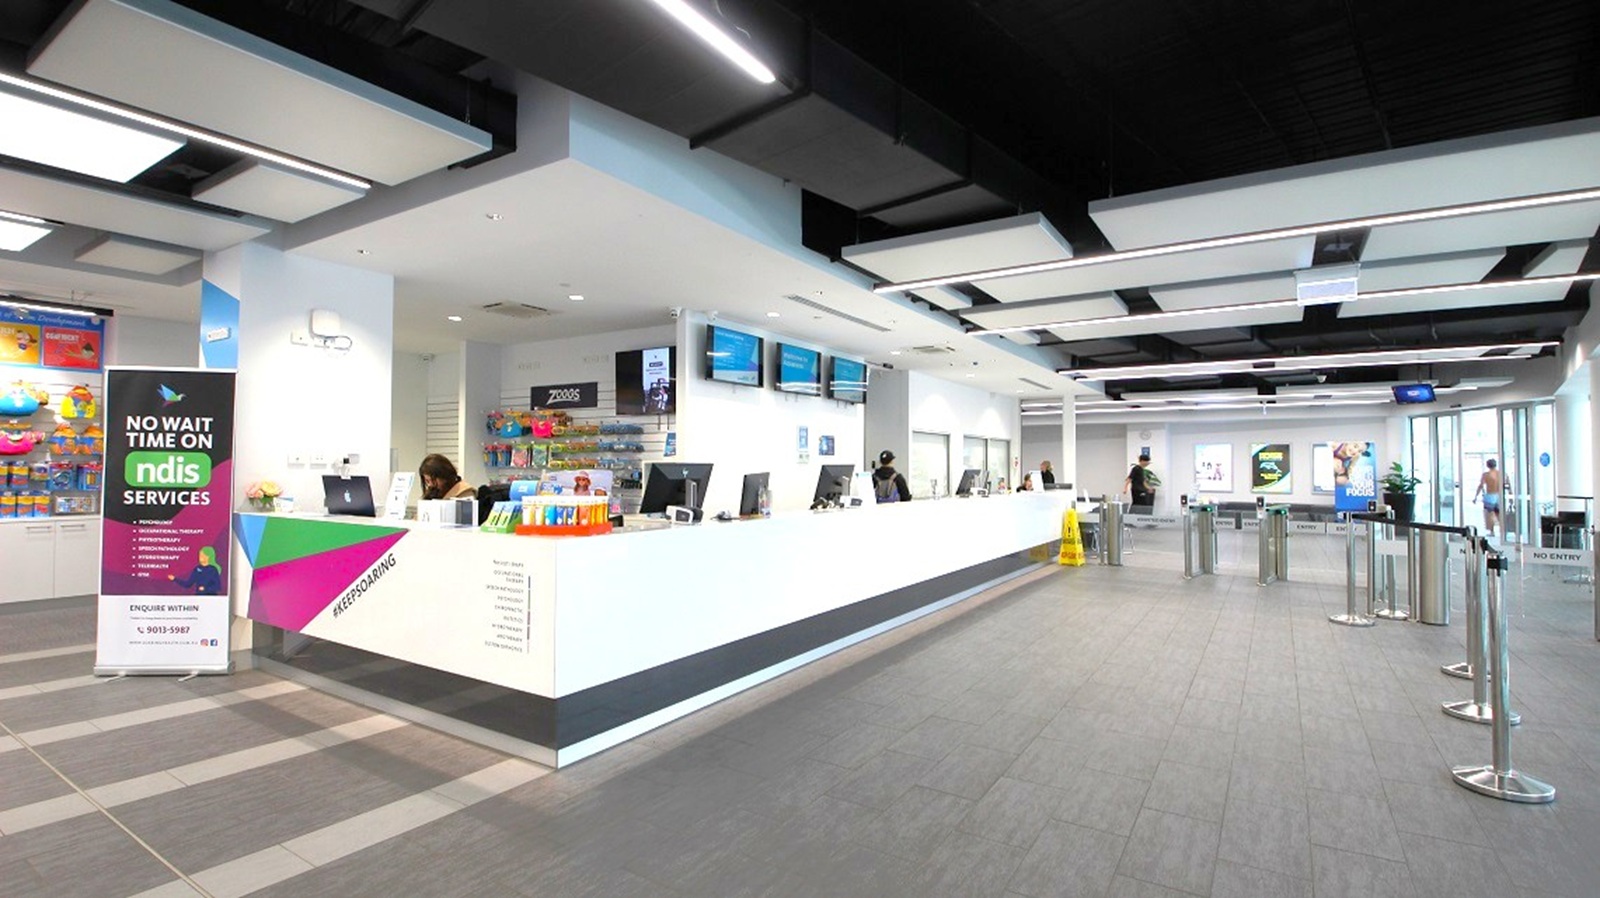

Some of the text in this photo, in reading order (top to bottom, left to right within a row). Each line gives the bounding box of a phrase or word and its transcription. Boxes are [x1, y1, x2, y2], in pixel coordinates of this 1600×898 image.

[126, 415, 214, 432] NO WAIT
[126, 432, 213, 449] TIME ON
[136, 455, 200, 484] ndis
[123, 490, 211, 505] SERVICES
[1346, 488, 1375, 497] FOCUS
[1533, 552, 1582, 561] NO ENTRY
[332, 552, 397, 619] #KEEPSOARING
[129, 604, 200, 613] ENQUIRE WITHIN
[146, 625, 190, 634] 9013-5987
